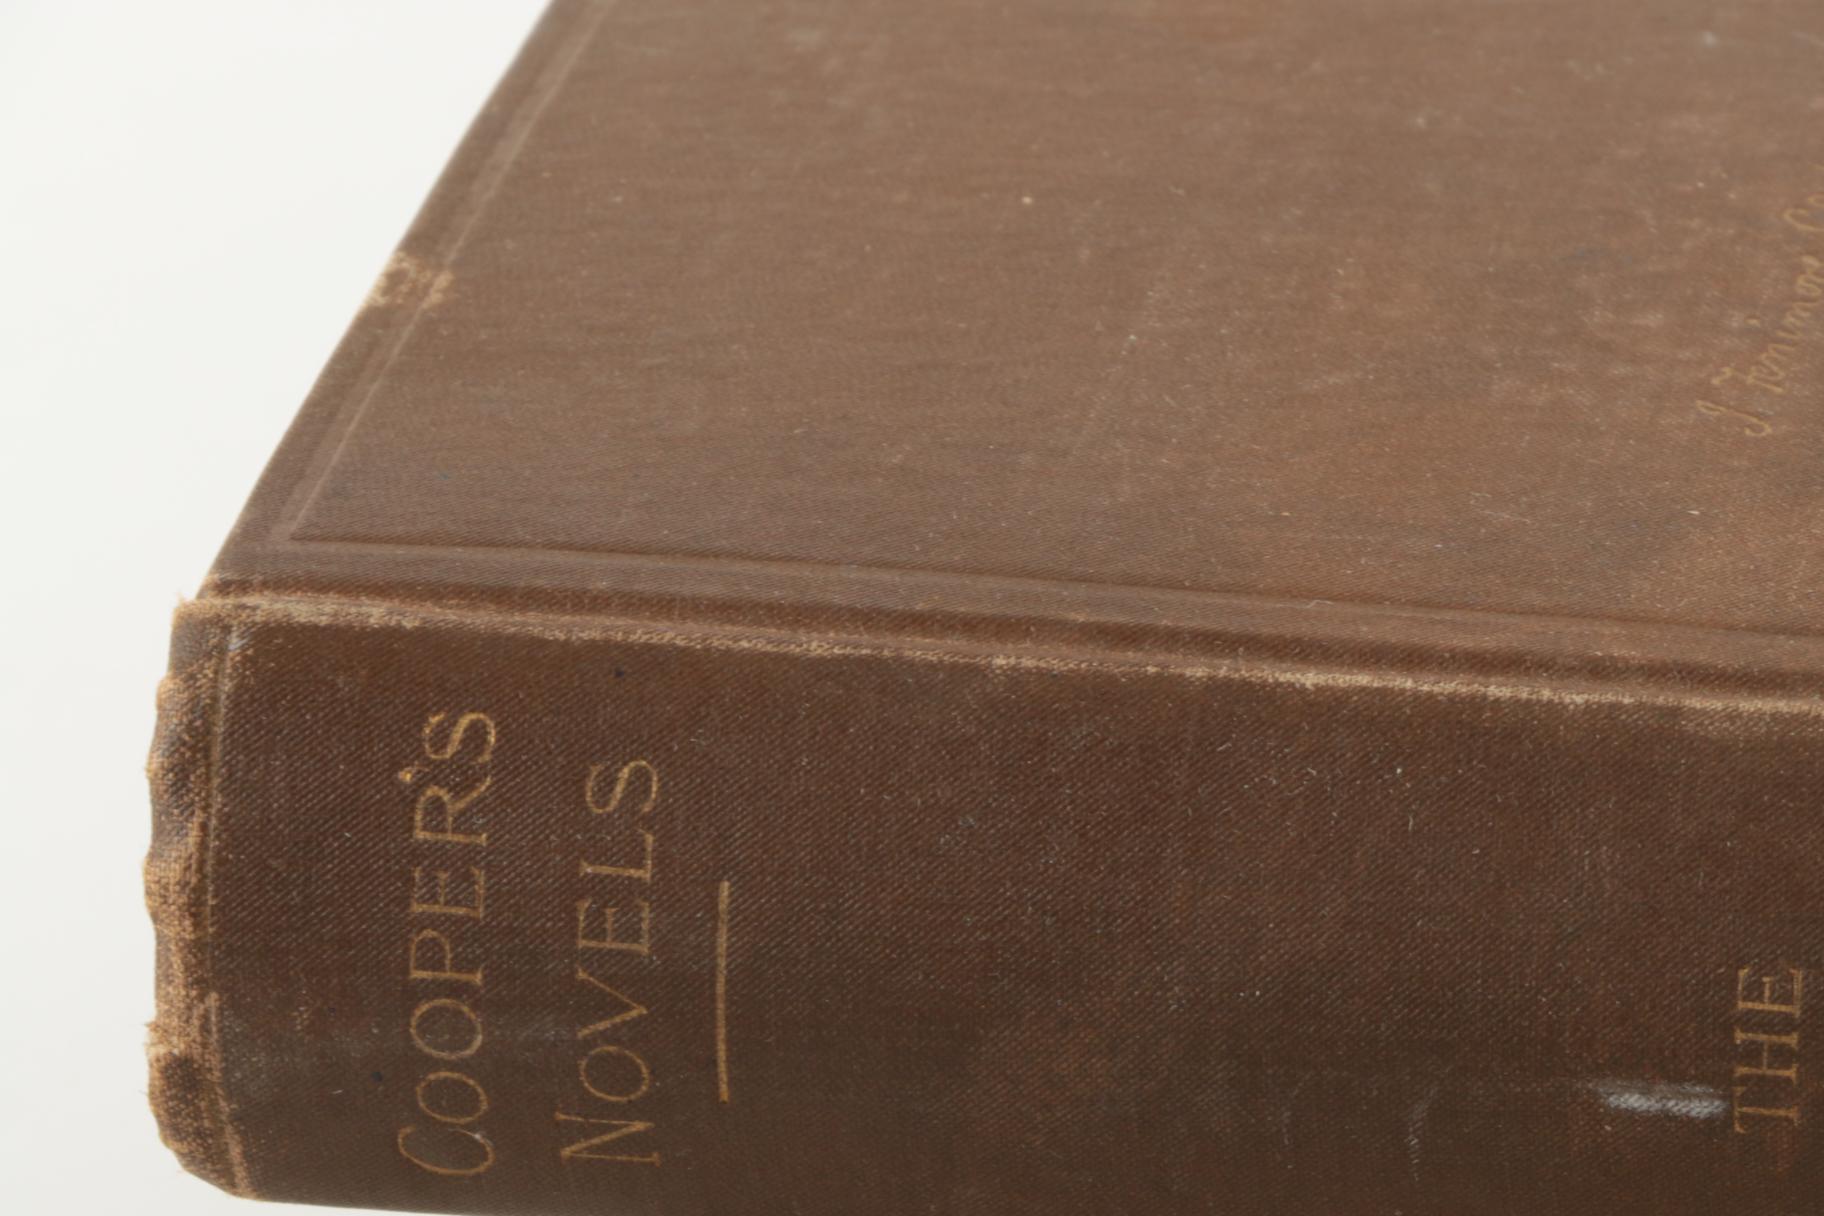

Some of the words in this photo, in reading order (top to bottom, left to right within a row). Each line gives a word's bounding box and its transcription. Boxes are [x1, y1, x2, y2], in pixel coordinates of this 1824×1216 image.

[397, 711, 497, 1177] COOPER'S
[554, 759, 660, 1169] NOVELS
[1733, 966, 1803, 1134] THE
